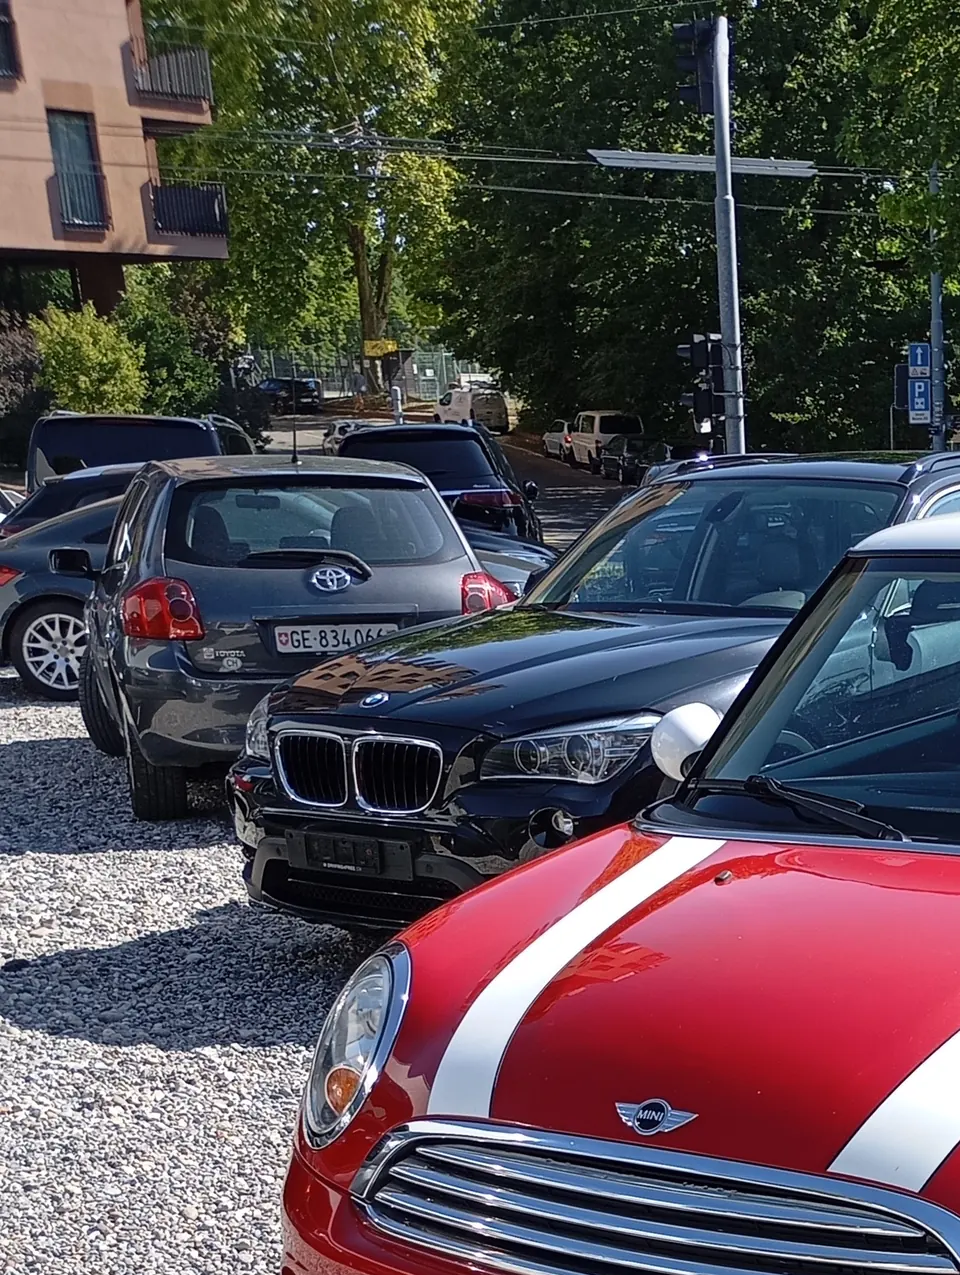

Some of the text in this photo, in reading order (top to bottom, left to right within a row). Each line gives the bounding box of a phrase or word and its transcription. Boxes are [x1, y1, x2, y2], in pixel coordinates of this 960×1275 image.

[915, 382, 925, 397] P
[227, 659, 239, 667] CH
[637, 1109, 664, 1121] MINI
